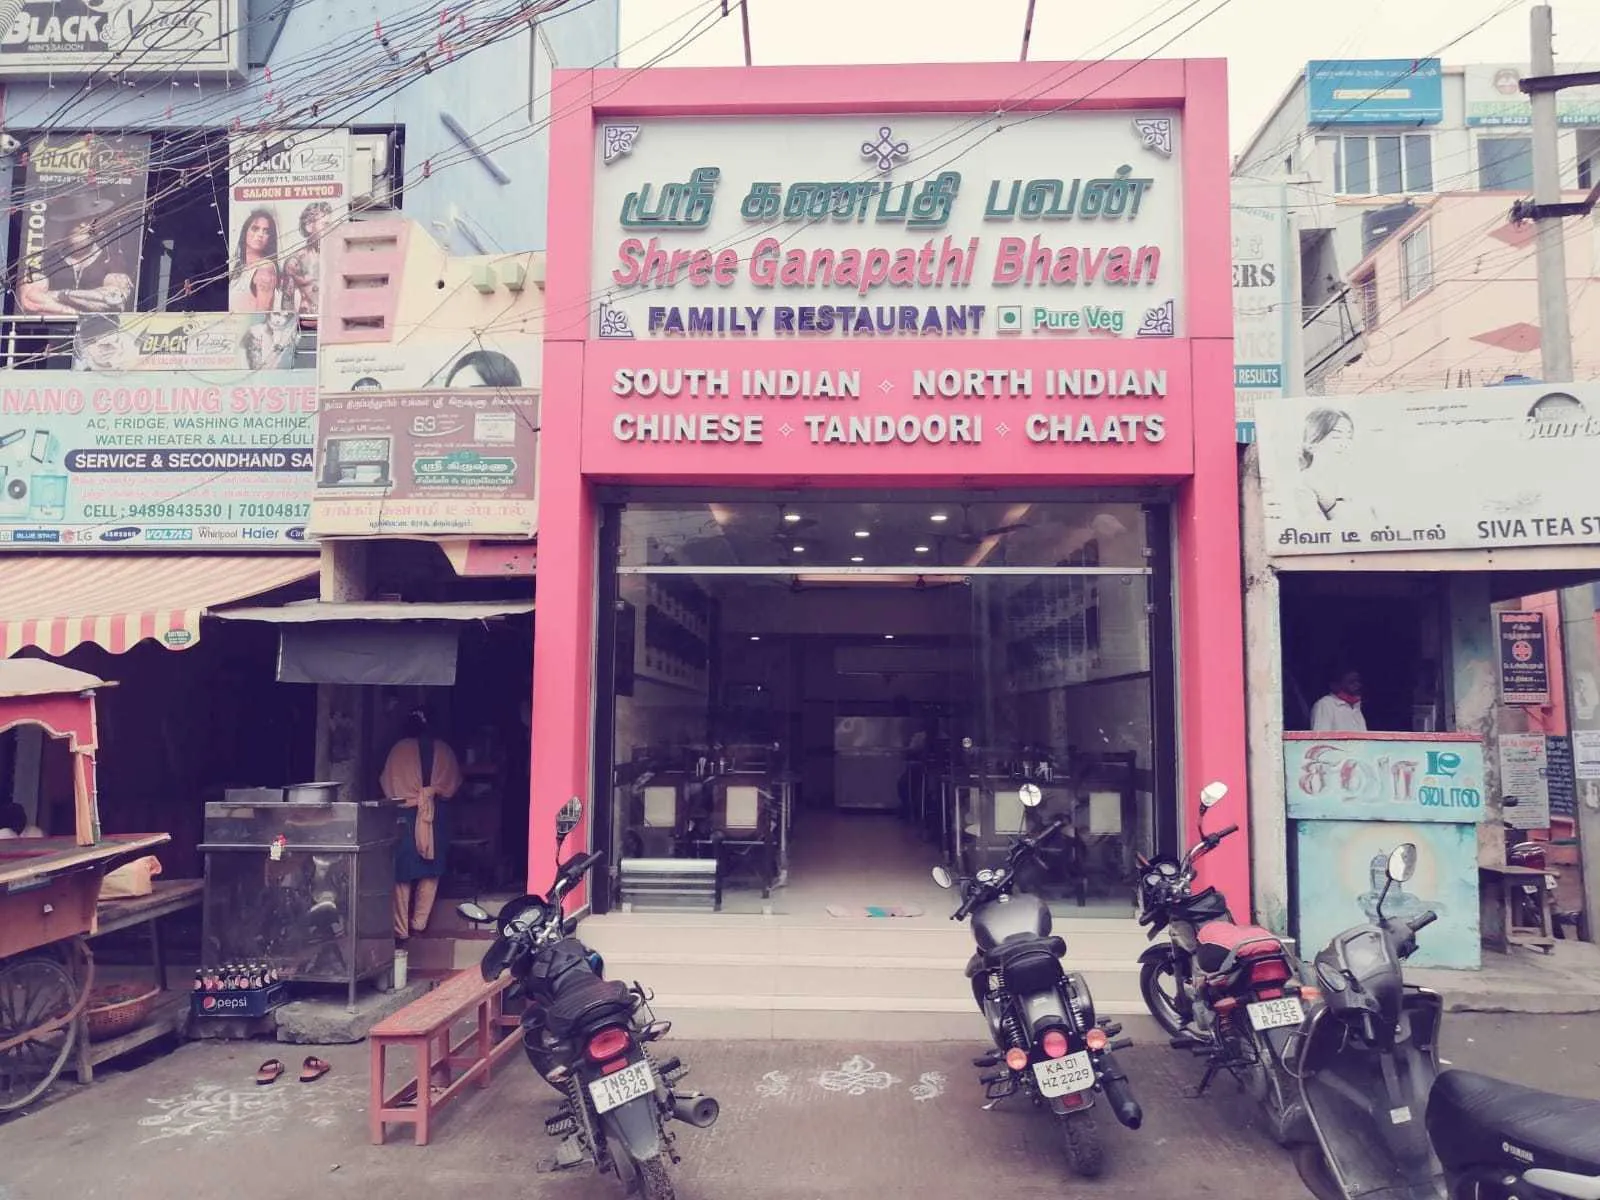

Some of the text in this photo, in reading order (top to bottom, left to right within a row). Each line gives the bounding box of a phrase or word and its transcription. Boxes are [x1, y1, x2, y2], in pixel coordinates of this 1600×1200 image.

[3, 11, 101, 44] BLACK
[40, 151, 88, 169] BLACK
[242, 187, 282, 199] SALOON
[294, 184, 335, 198] TATTOO
[741, 170, 963, 230] கணபதி
[983, 164, 1155, 222] பவன்
[612, 235, 1162, 297] Shree Ganapathi Bhavan
[648, 304, 985, 336] FAMILY RESTAURANT
[1033, 307, 1125, 331] Pure Veg
[142, 335, 188, 352] BLACK
[612, 368, 862, 399] SOUTH INDIAN
[912, 368, 1168, 399] NORTH INDIAN
[1238, 367, 1279, 385] RESULTS
[3, 387, 86, 416] NANO
[93, 386, 221, 415] COOLING
[86, 416, 310, 431] AC, FRIDGE, WASHING MACHINE,
[612, 413, 764, 444] CHINESE
[804, 414, 983, 445] TANDOORI
[1025, 413, 1167, 444] CHAATS
[95, 434, 143, 446] WATER
[147, 434, 202, 446] HEATER
[206, 434, 217, 445] &
[220, 433, 247, 445] ALL
[250, 433, 278, 445] LED
[75, 453, 146, 468] SERVICE
[150, 454, 163, 468] &
[168, 453, 286, 468] SECONDHAND
[128, 503, 222, 518] 9489843530
[76, 529, 93, 541] LG
[146, 529, 192, 540] VOLTAS
[198, 527, 238, 541] Whirlpool
[242, 526, 279, 539] Haier
[1278, 527, 1333, 545] சிவா
[1370, 523, 1447, 542] ஸ்டால்
[1477, 519, 1527, 539] SIVA
[1531, 517, 1575, 537] TEA
[217, 995, 247, 1009] pepsi
